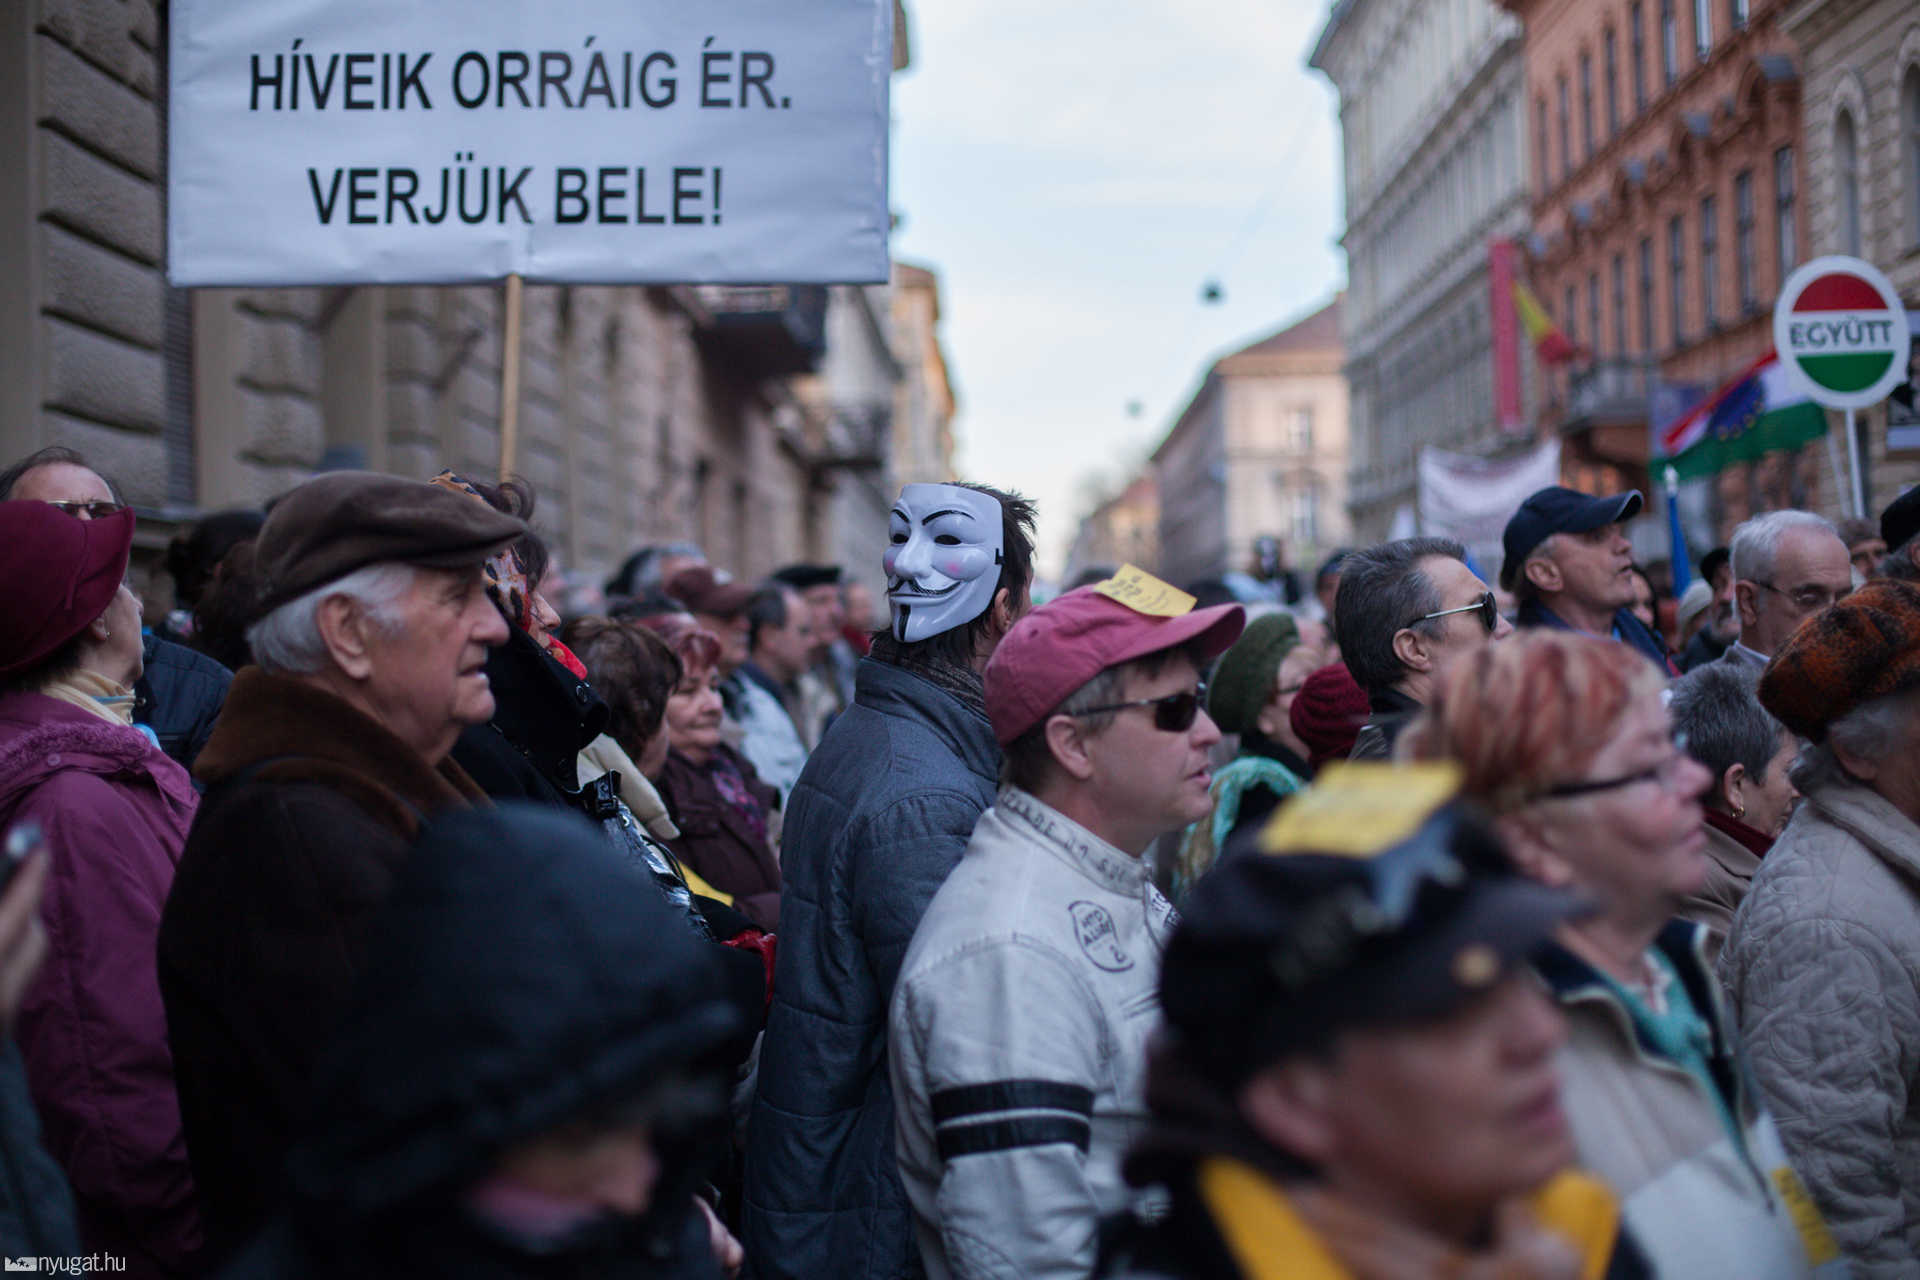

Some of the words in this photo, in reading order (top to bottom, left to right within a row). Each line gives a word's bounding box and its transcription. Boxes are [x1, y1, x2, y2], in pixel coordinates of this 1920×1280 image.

[249, 38, 433, 111] HÍVEIK
[451, 36, 678, 110] ORRÁIG
[700, 36, 792, 109] ÉR.
[307, 152, 533, 225] VERJÜK
[554, 167, 722, 225] BELE!
[1789, 316, 1893, 347] EGYÜTT
